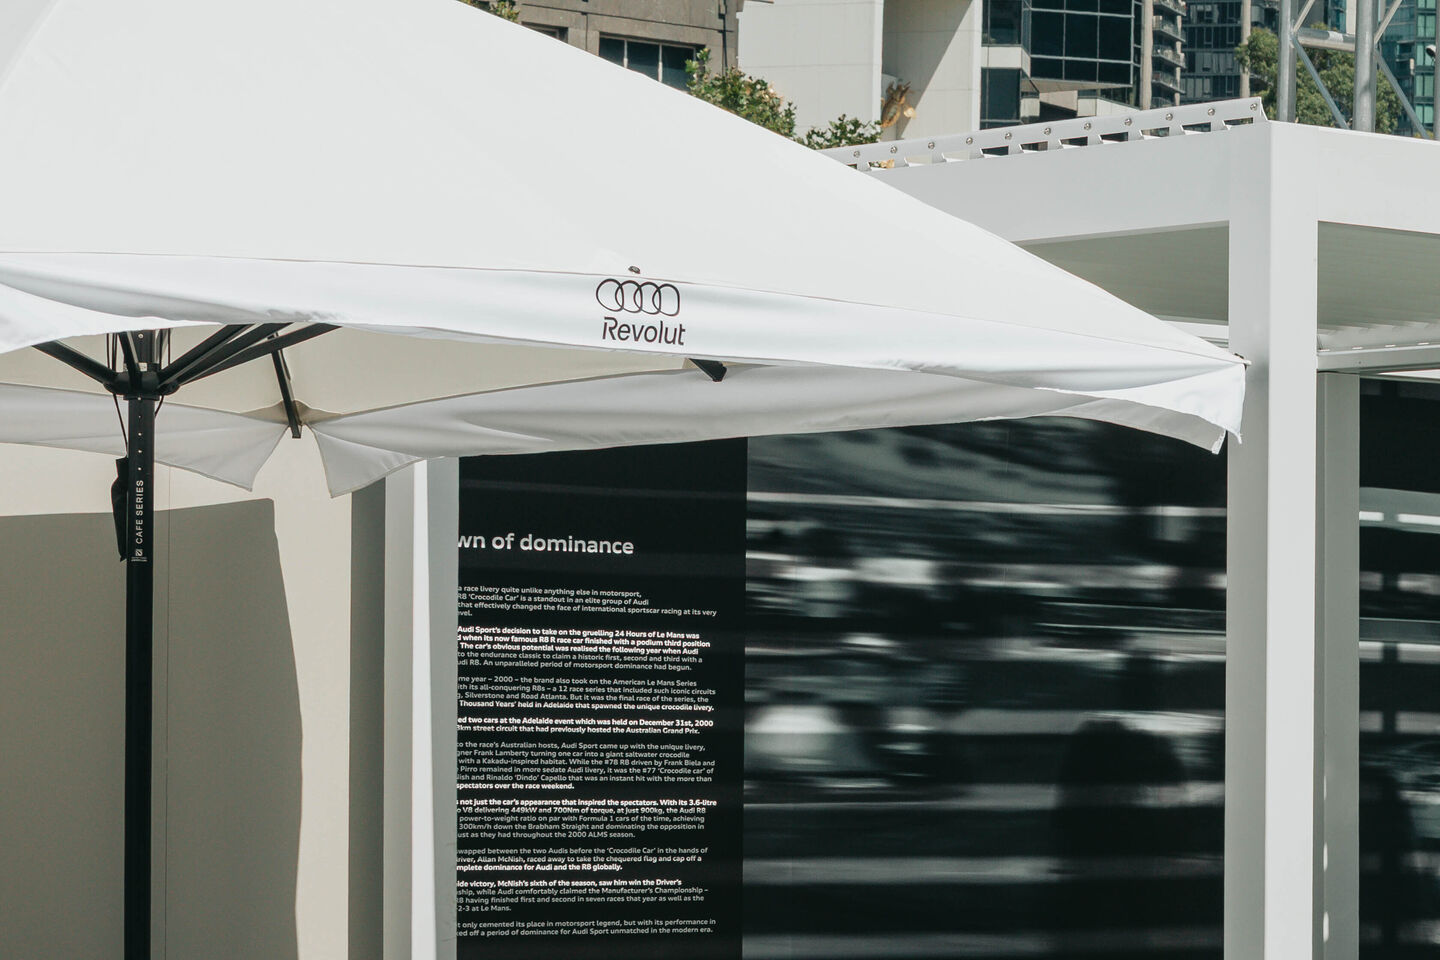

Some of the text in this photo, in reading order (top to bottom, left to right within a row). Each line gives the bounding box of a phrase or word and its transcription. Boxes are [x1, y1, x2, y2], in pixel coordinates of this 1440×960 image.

[602, 316, 686, 346] Revolut
[136, 480, 144, 544] CAFE SERIES
[458, 533, 635, 554] wn of dominance
[501, 627, 531, 635] decision
[581, 629, 614, 638] gruelling
[625, 630, 647, 638] Hours
[665, 631, 685, 639] Mans
[460, 699, 494, 707] Thousand
[517, 700, 534, 708] held
[542, 701, 574, 709] Adelaide
[574, 701, 590, 709] that
[590, 702, 622, 711] spawned
[636, 702, 660, 712] unique
[660, 703, 693, 711] crocodile
[483, 863, 523, 871] dominance
[535, 863, 553, 871] Audi
